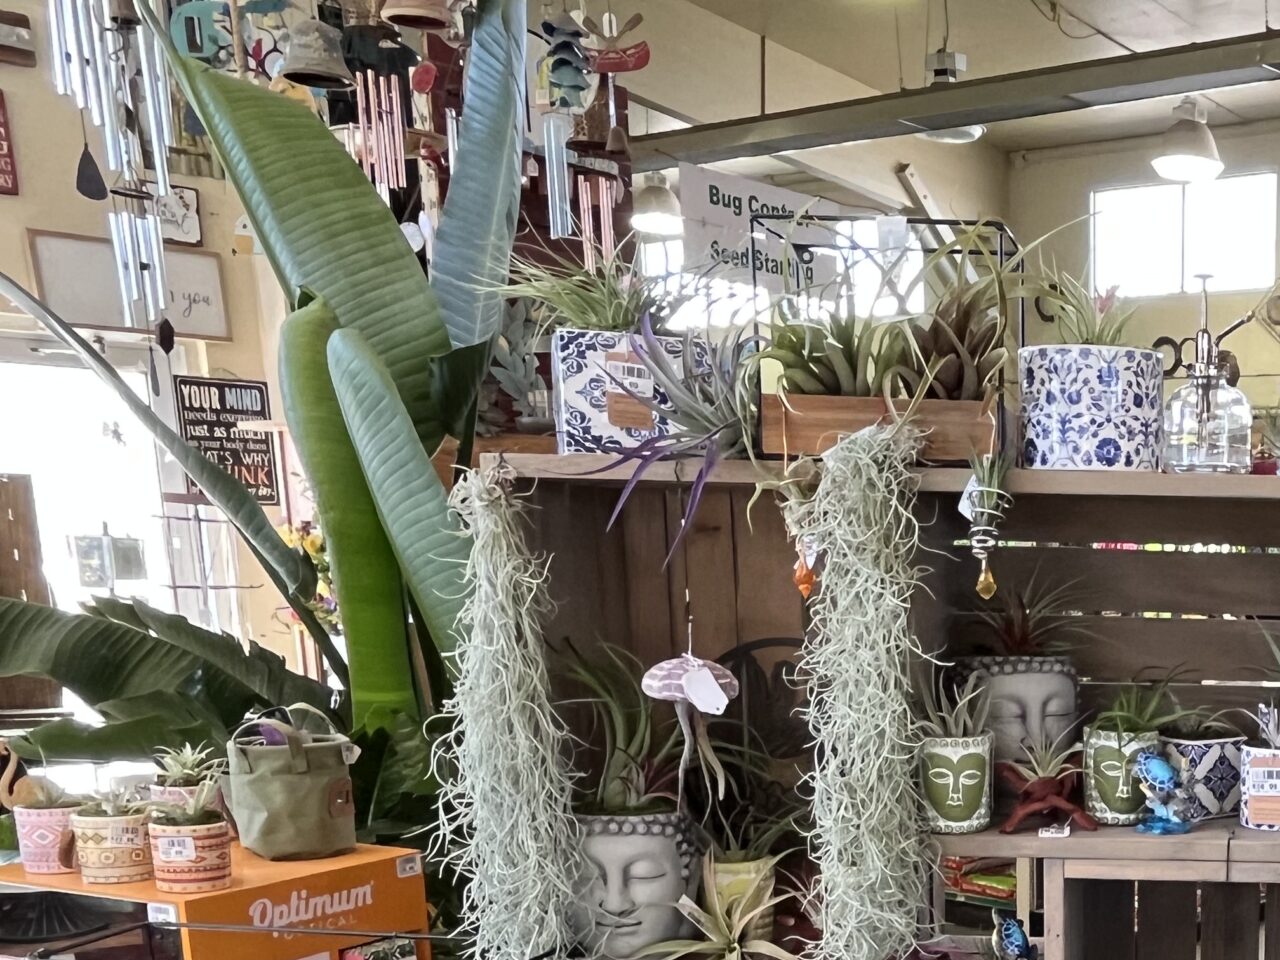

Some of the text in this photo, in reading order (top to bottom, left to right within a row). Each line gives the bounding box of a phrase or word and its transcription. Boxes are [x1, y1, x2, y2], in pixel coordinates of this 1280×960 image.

[708, 184, 810, 228] Bug Contl
[752, 248, 814, 285] Startig
[181, 384, 262, 411] YOUR MIND
[213, 427, 227, 438] as
[201, 450, 271, 467] AT'S WHY
[227, 465, 270, 485] INK
[249, 881, 374, 938] Optimum
